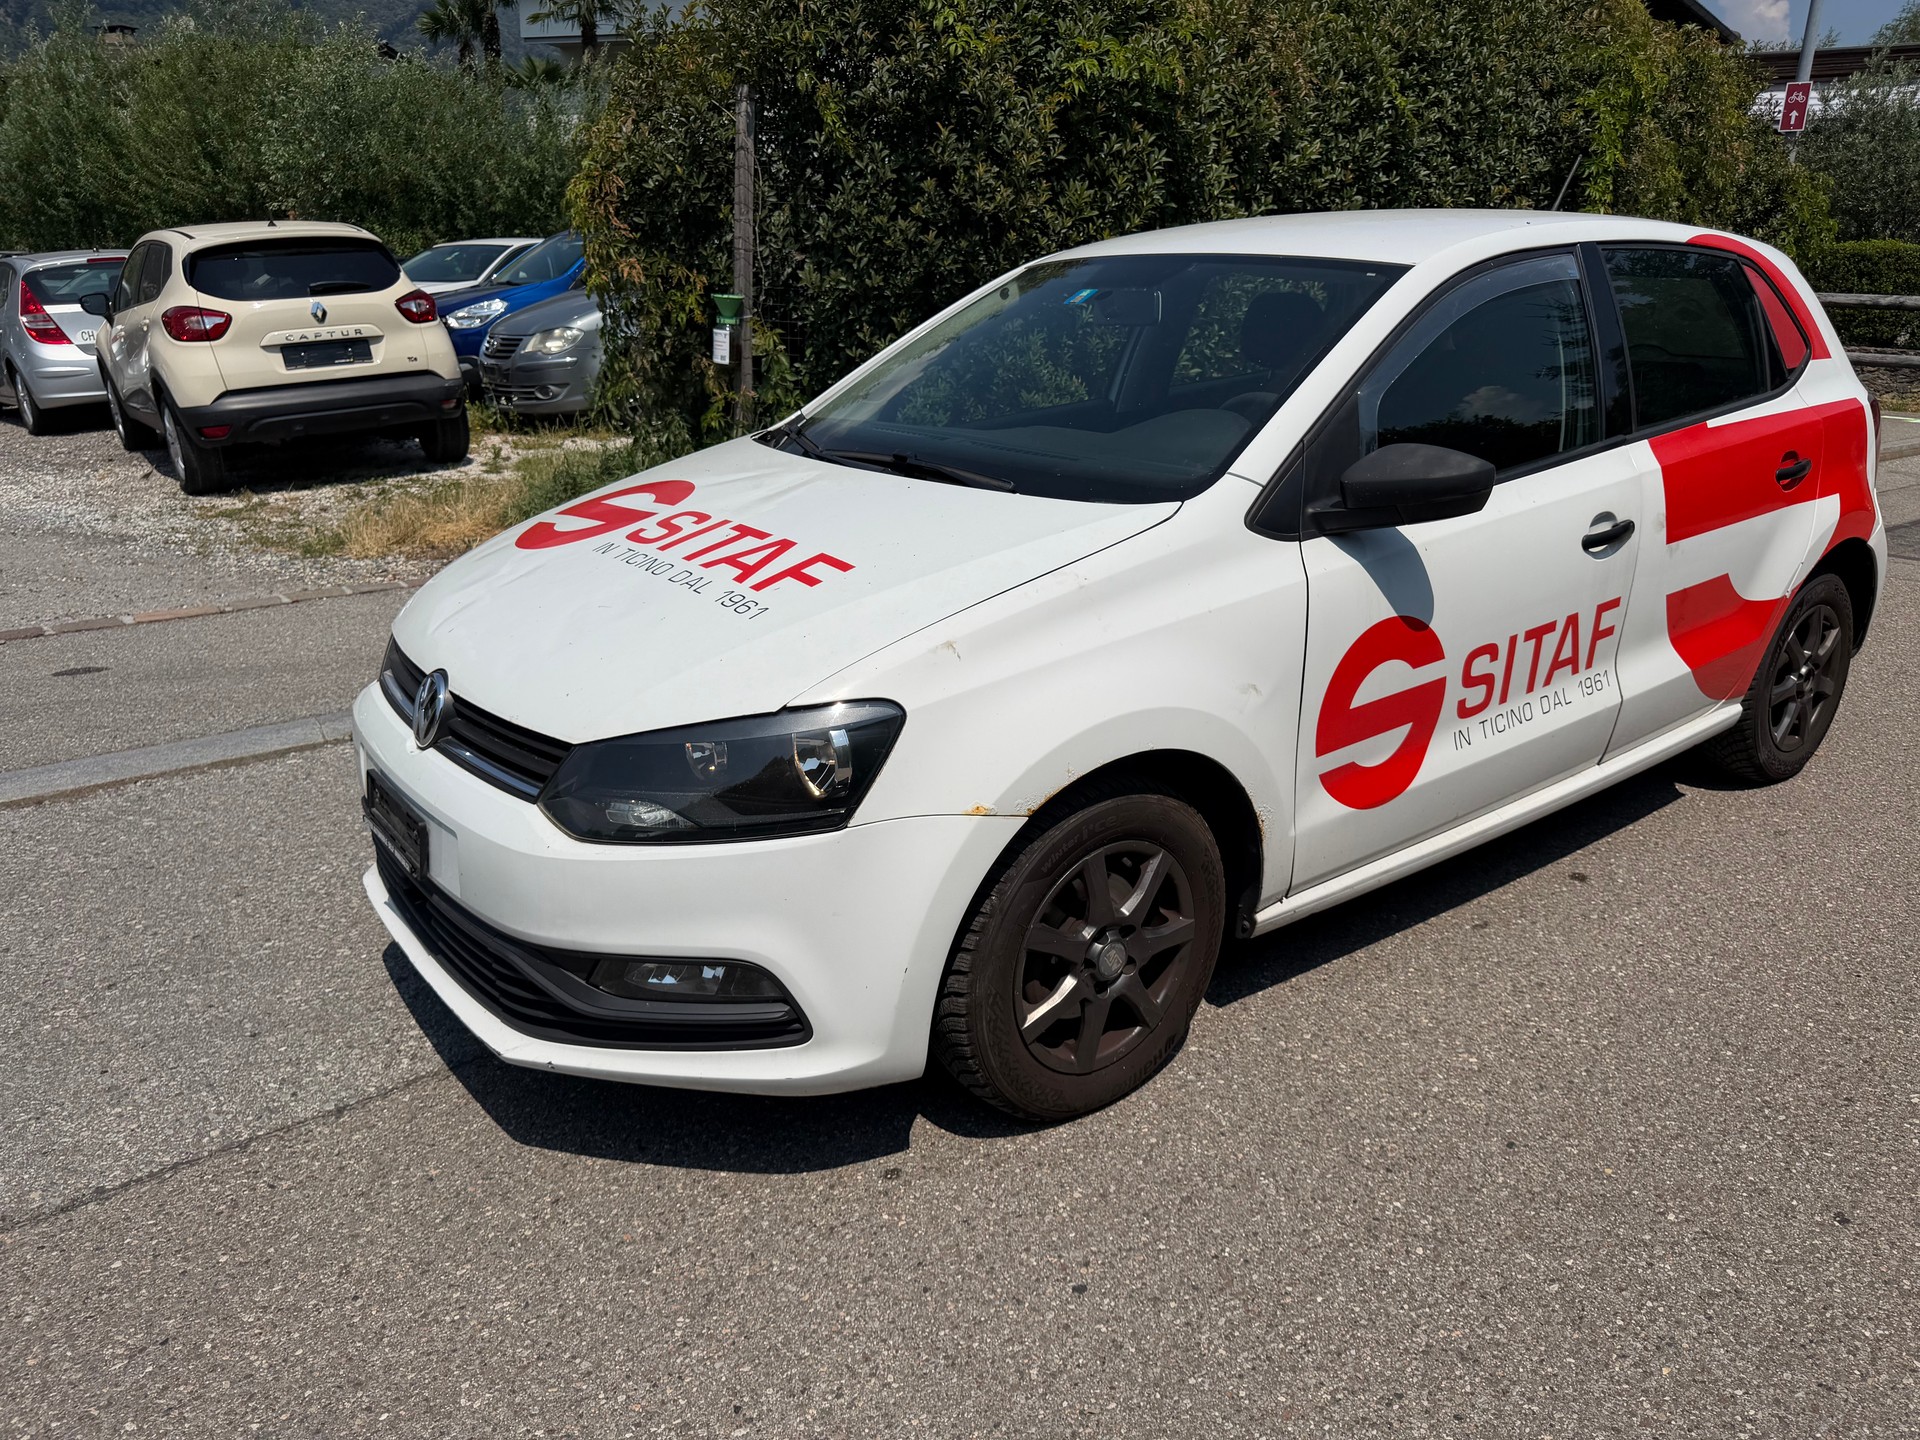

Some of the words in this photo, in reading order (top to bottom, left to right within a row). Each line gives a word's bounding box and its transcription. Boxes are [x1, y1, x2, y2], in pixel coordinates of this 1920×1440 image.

[80, 330, 96, 342] CH
[285, 328, 364, 342] CAPTUR
[592, 541, 621, 555] IN
[613, 547, 675, 576] TICINO
[667, 569, 713, 595] DAL
[714, 590, 770, 620] 1961
[625, 510, 856, 592] SITAF
[1456, 596, 1622, 720] SITAF
[1453, 726, 1472, 751] IN
[1478, 701, 1534, 740] TICINO
[1539, 687, 1572, 715] DAL
[1577, 669, 1611, 699] 1961
